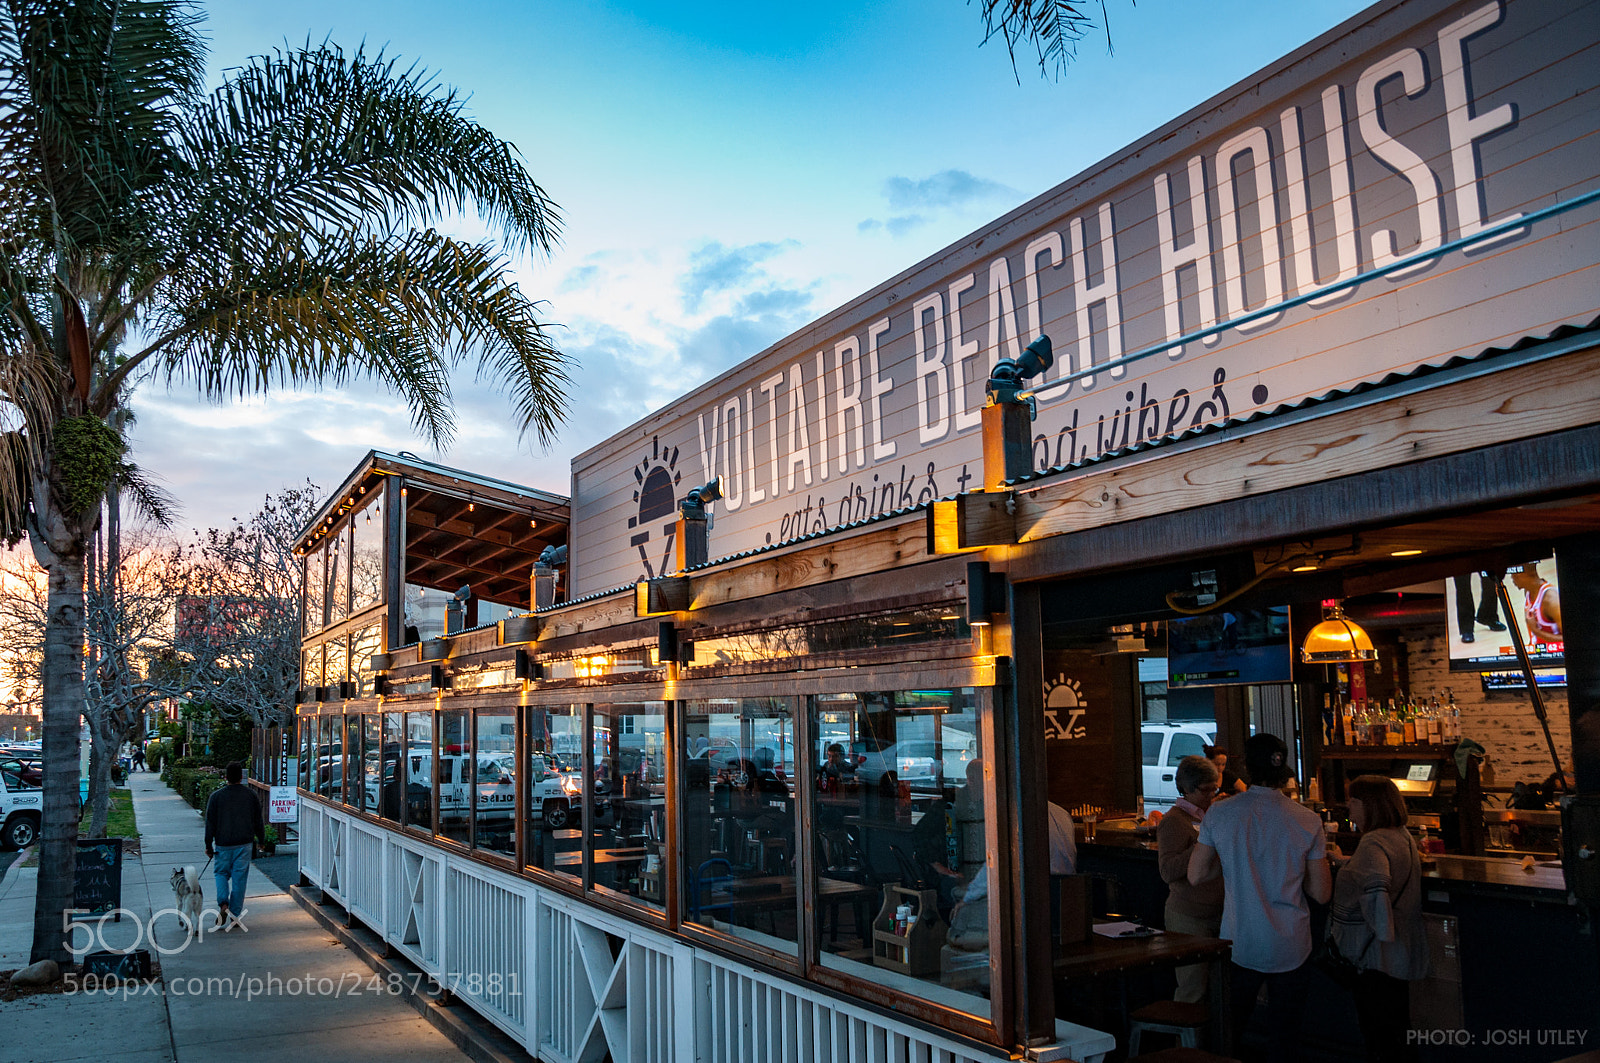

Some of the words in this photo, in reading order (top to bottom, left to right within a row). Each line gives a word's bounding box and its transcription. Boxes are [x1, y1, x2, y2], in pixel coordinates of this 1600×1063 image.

[697, 316, 897, 512] VOLTAIRE
[913, 201, 1126, 444] BEACH
[1154, 0, 1527, 358] HOUSE
[780, 494, 828, 542] eats
[839, 461, 939, 526] drinks
[1097, 367, 1230, 458] vibes
[271, 799, 296, 807] PARKING
[276, 806, 291, 814] ONLY
